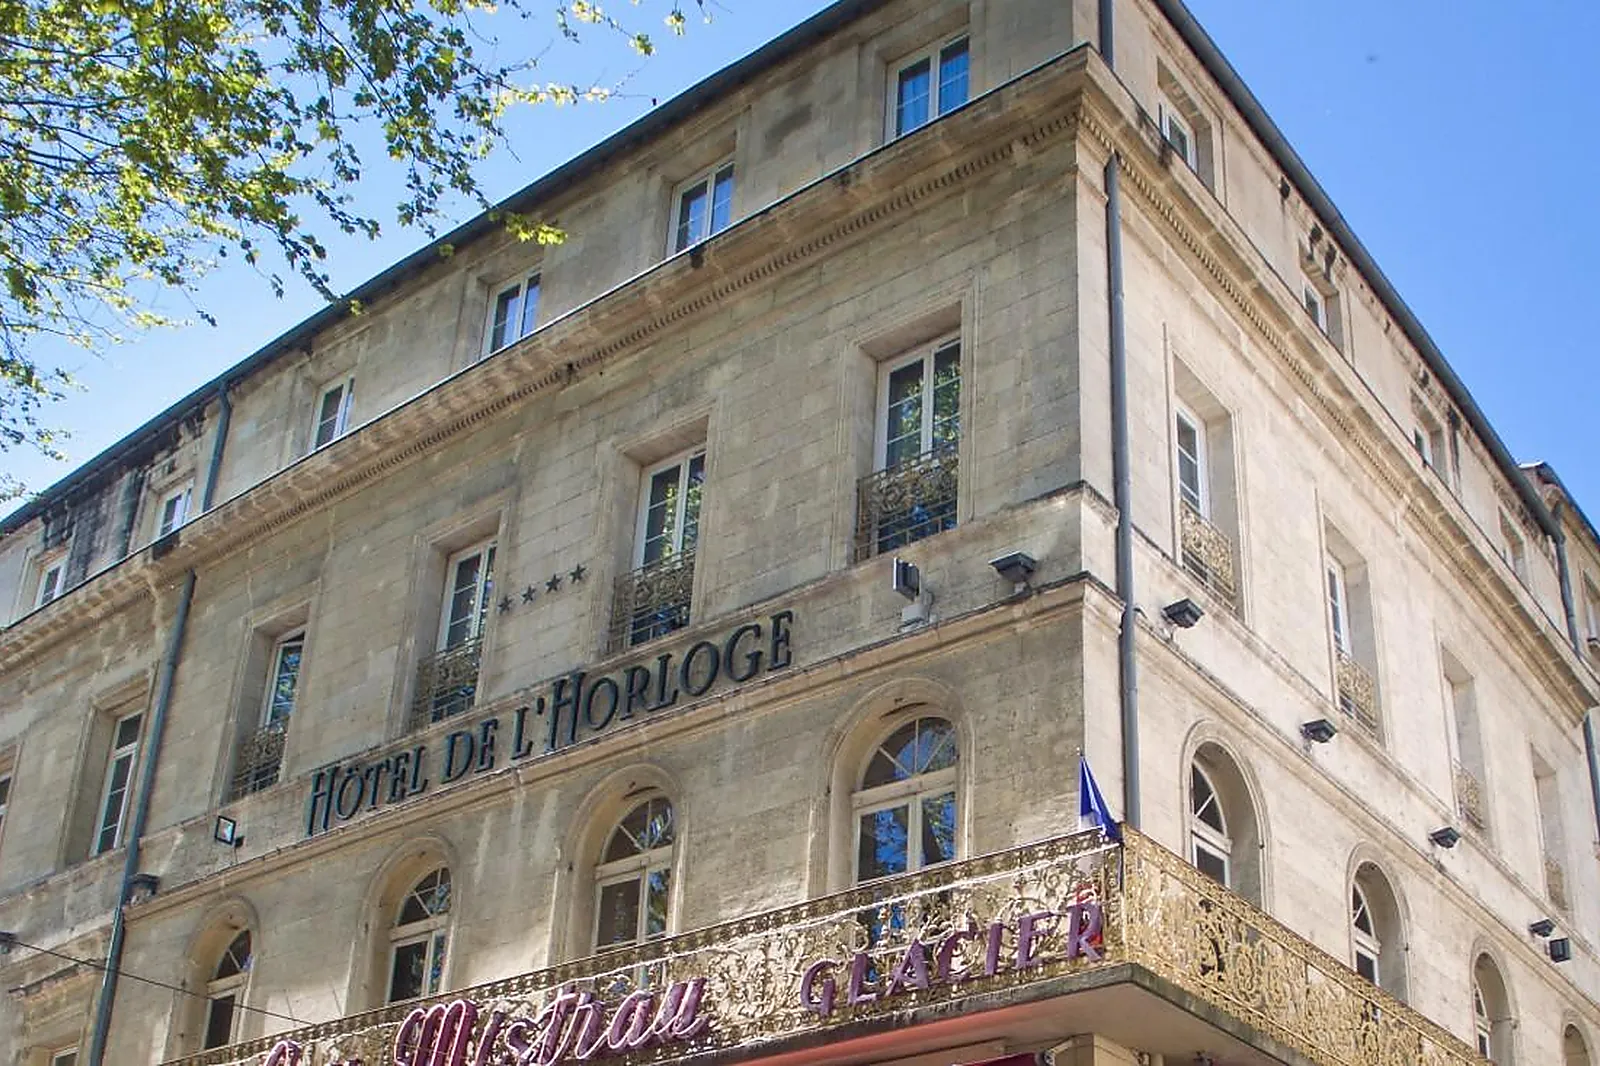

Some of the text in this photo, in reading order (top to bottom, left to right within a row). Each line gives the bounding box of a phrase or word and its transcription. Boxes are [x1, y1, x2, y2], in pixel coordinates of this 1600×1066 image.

[440, 718, 499, 784] DE
[510, 609, 793, 754] L'HORLOGE
[801, 900, 1104, 1016] GLACIER
